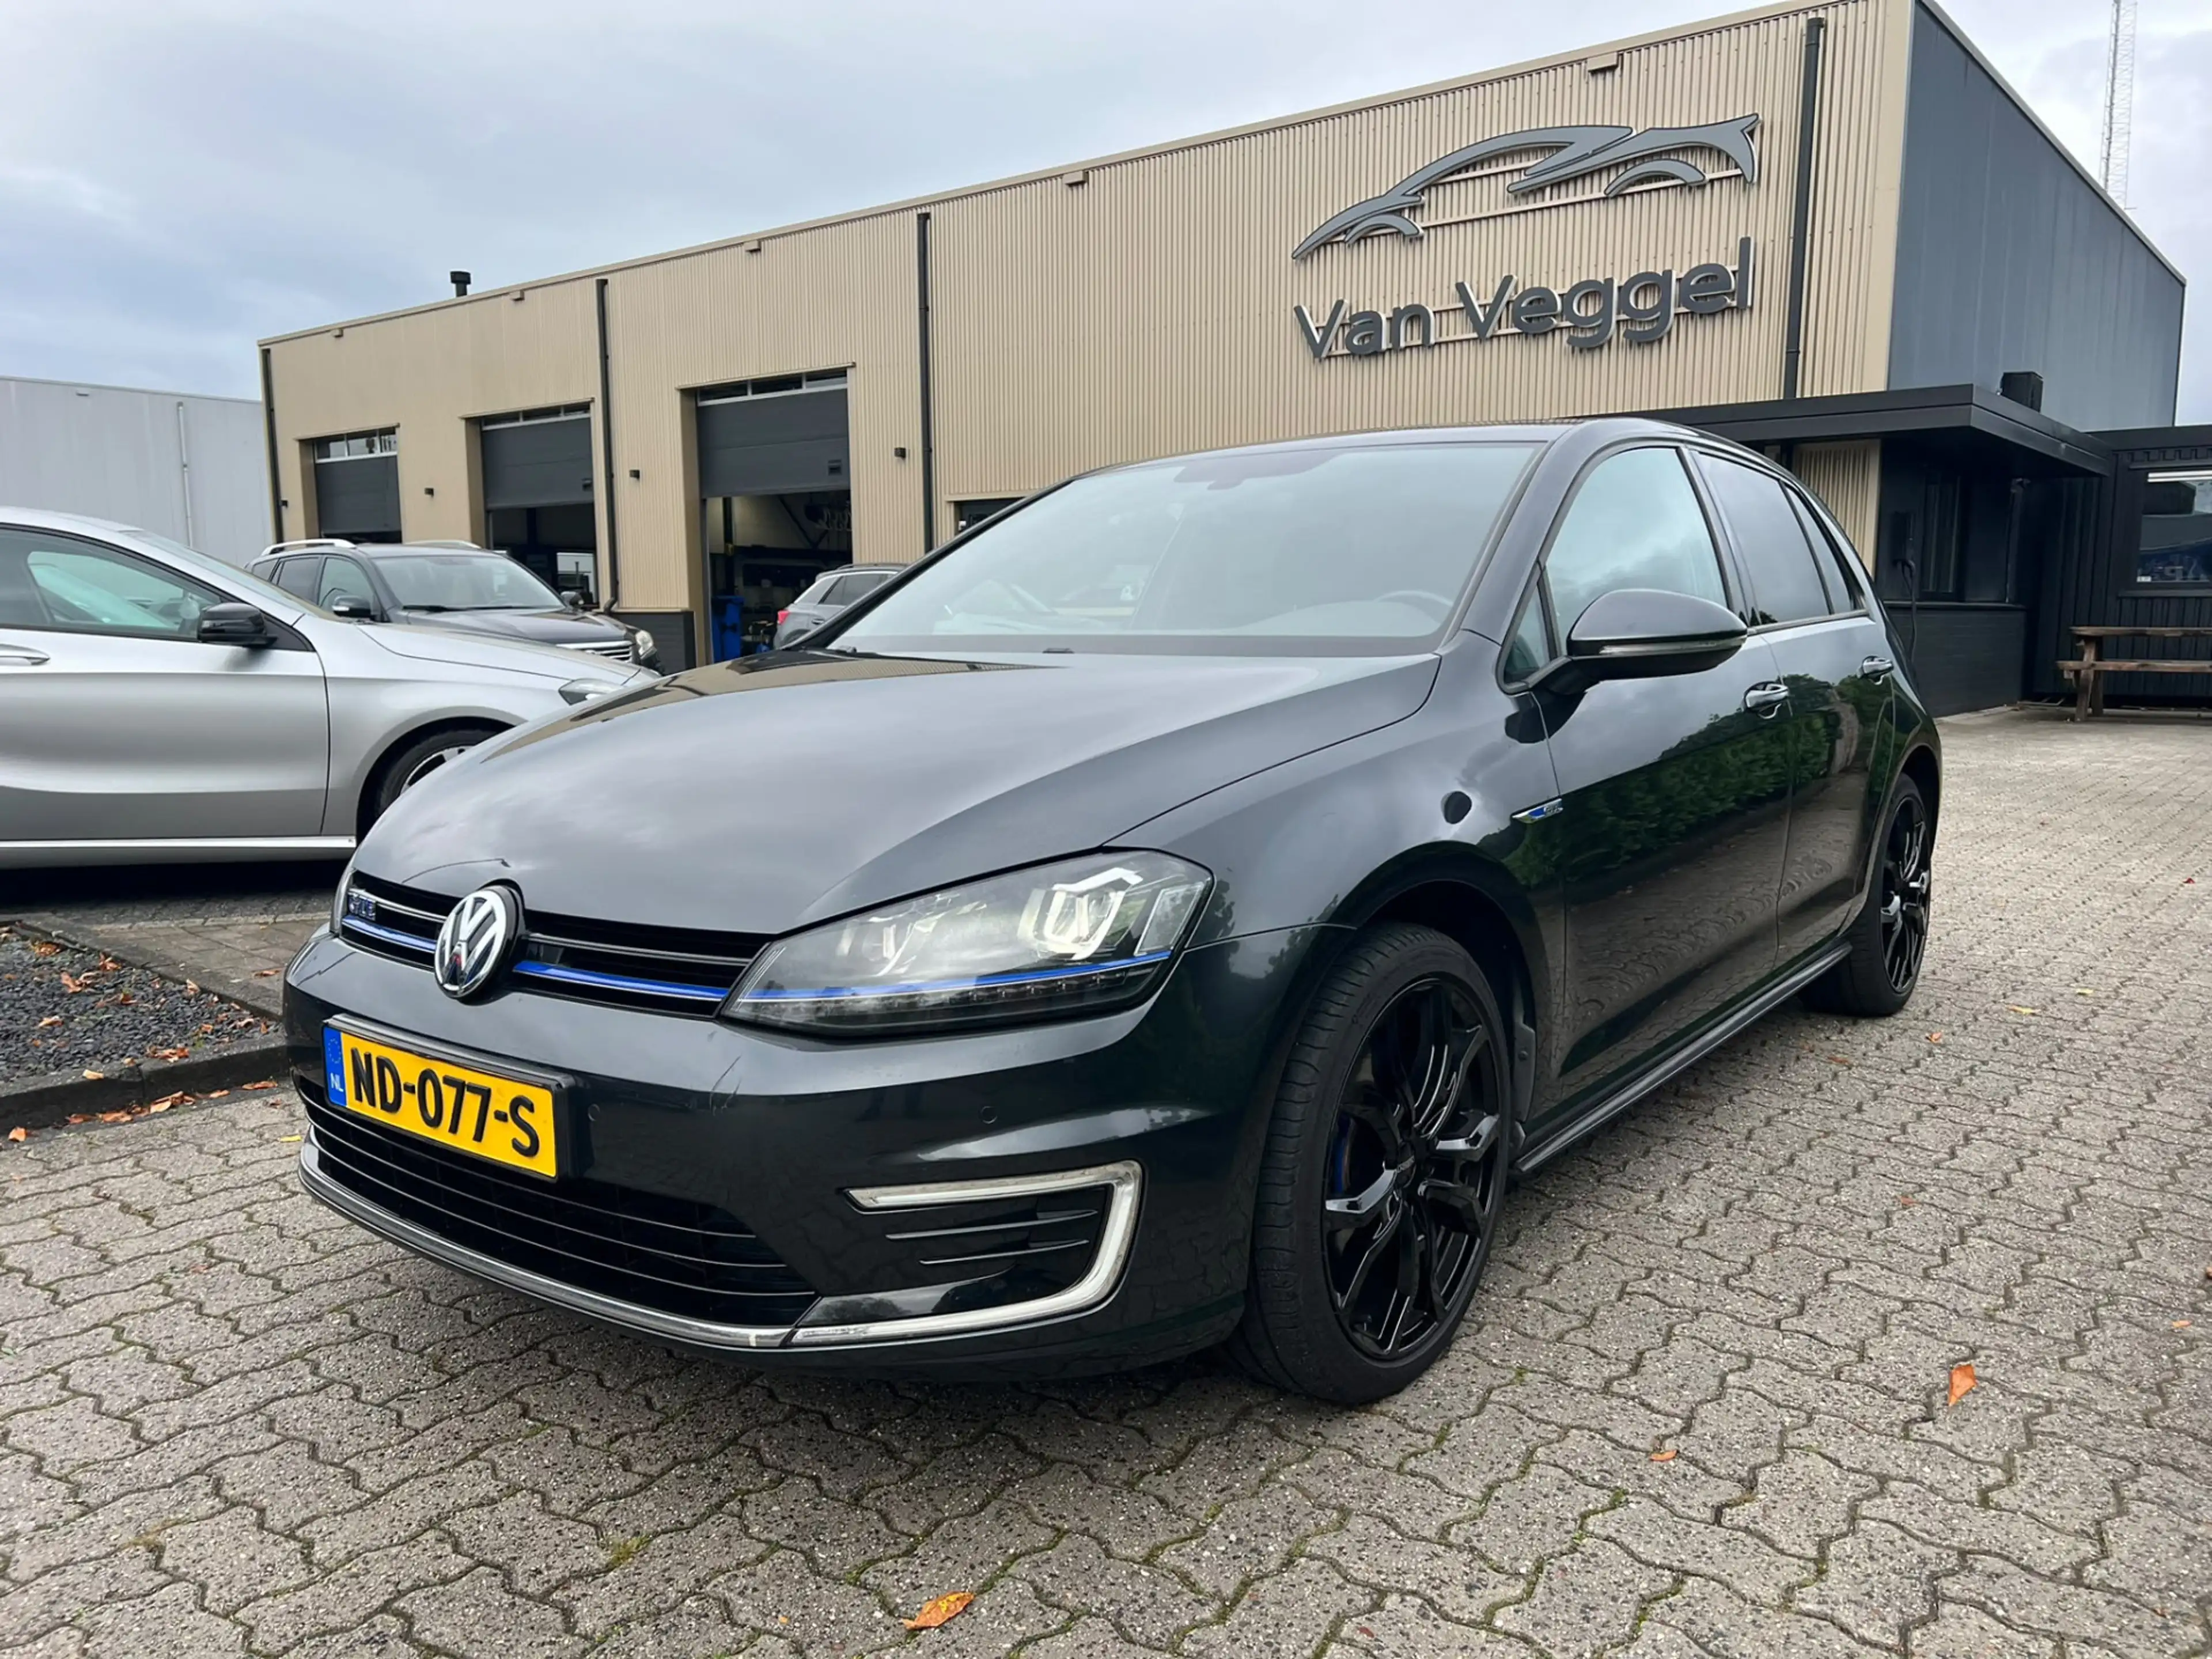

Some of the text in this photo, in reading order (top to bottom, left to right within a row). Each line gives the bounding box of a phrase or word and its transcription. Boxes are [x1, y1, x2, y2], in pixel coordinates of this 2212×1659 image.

[1294, 236, 1755, 361] Van Veggel
[330, 1072, 344, 1093] NL
[350, 1047, 540, 1157] ND-077-S
